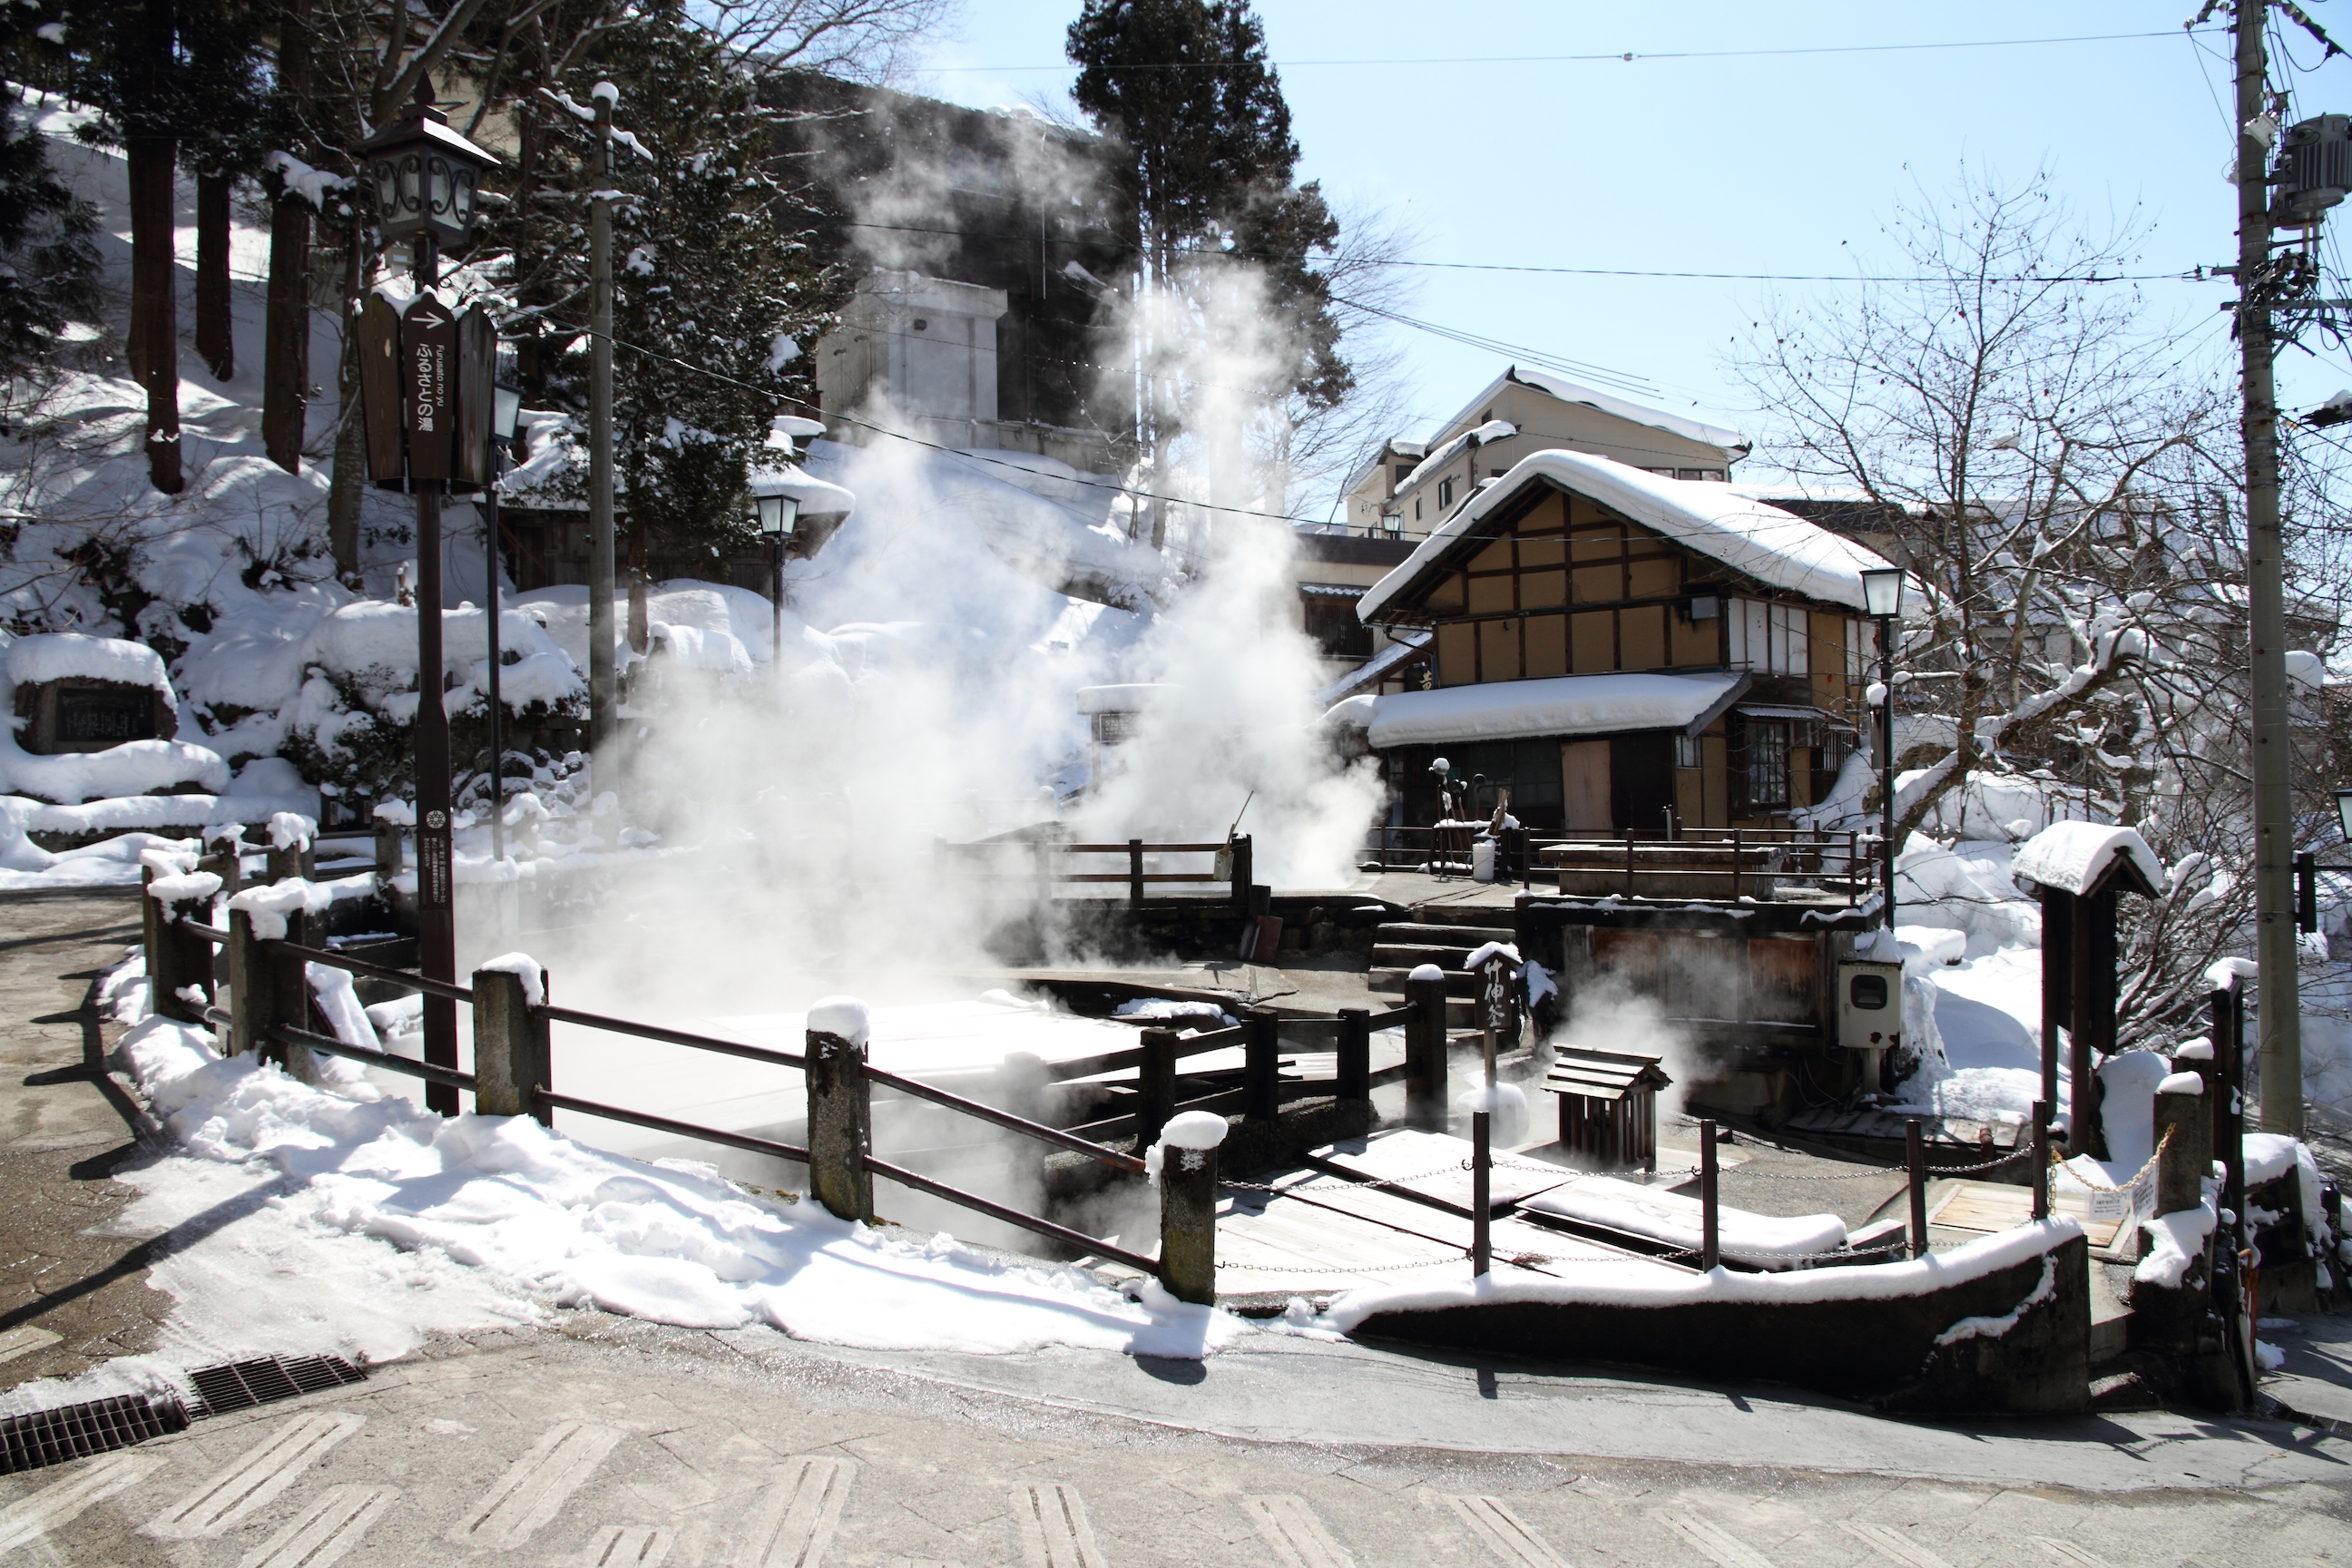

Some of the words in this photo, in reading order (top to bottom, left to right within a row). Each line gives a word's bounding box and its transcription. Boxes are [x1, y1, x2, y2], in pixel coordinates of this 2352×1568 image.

[436, 344, 445, 381] Furusato
[416, 344, 434, 432] ふるさとの湯
[436, 384, 444, 395] no
[436, 396, 444, 407] yu
[1484, 958, 1505, 1027] 竹伸釜
